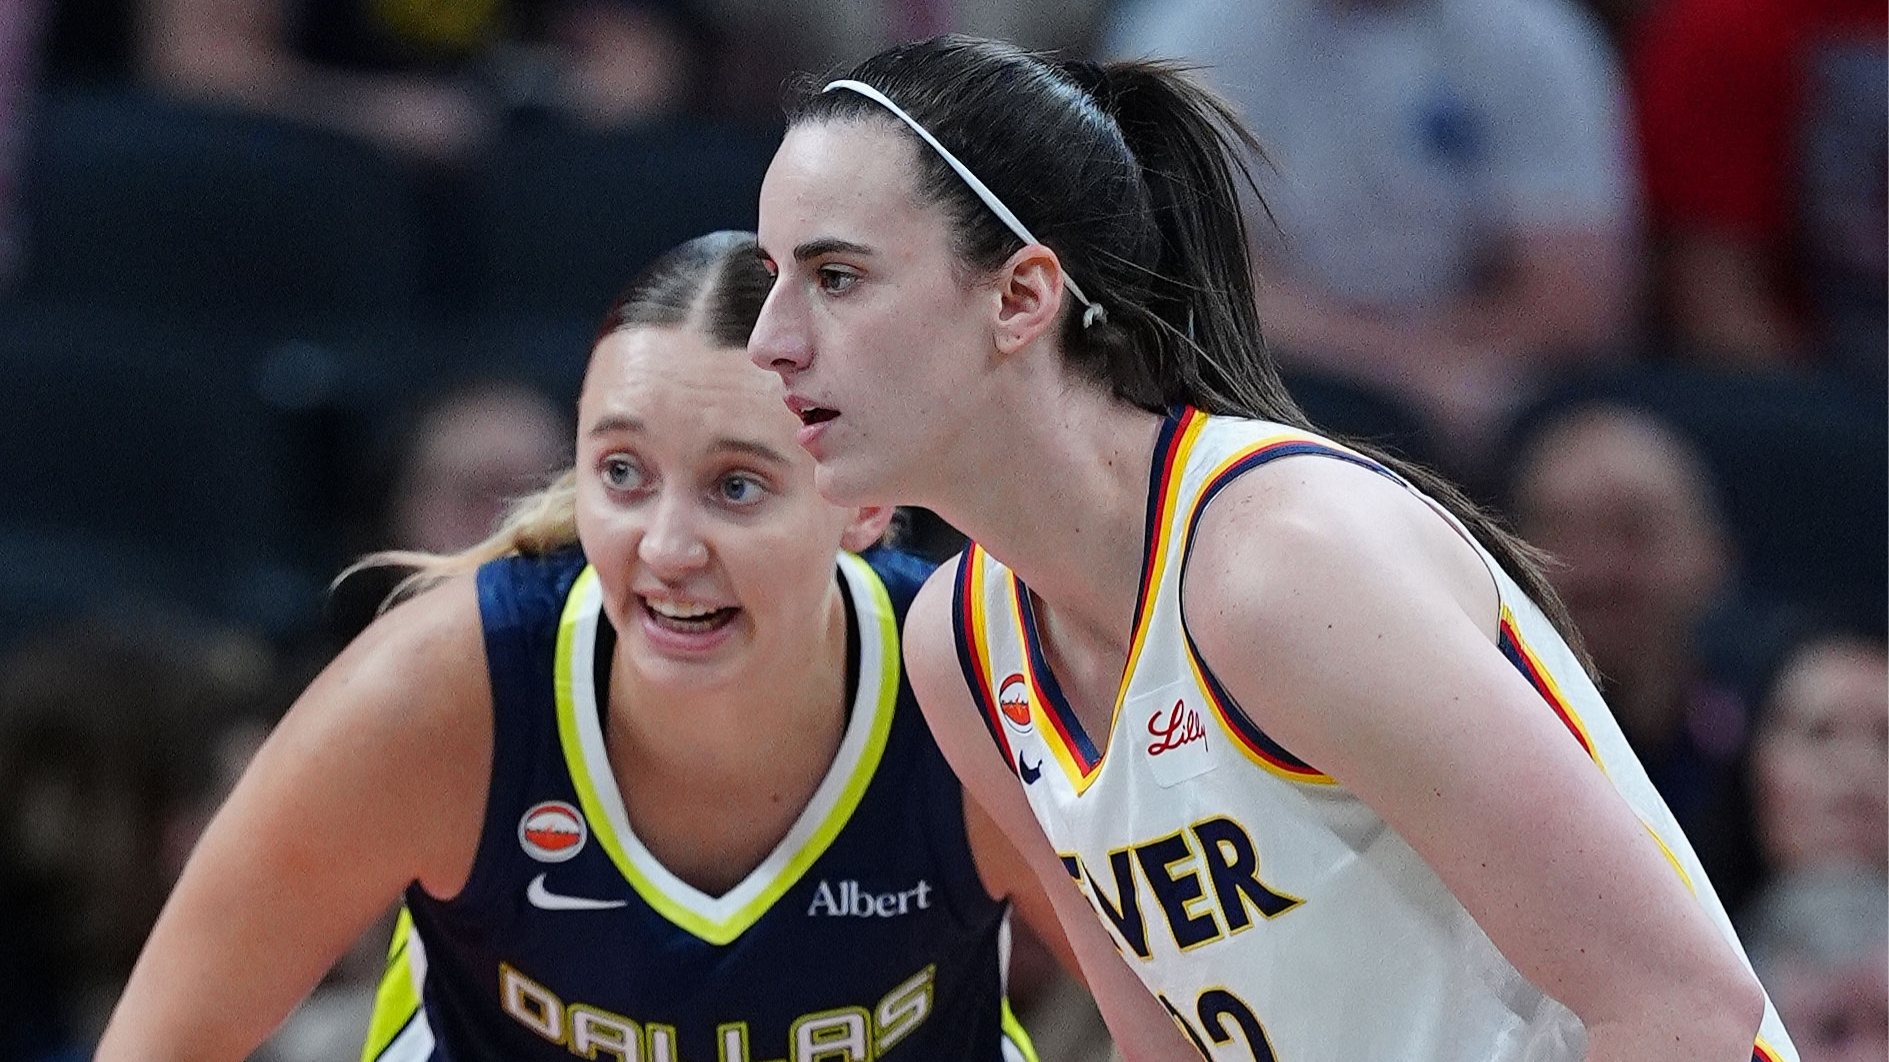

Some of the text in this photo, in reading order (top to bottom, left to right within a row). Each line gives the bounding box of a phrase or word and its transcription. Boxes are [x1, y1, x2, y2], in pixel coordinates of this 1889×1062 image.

[1147, 698, 1209, 756] Lilly
[807, 879, 933, 918] Albert
[1058, 813, 1307, 961] VER
